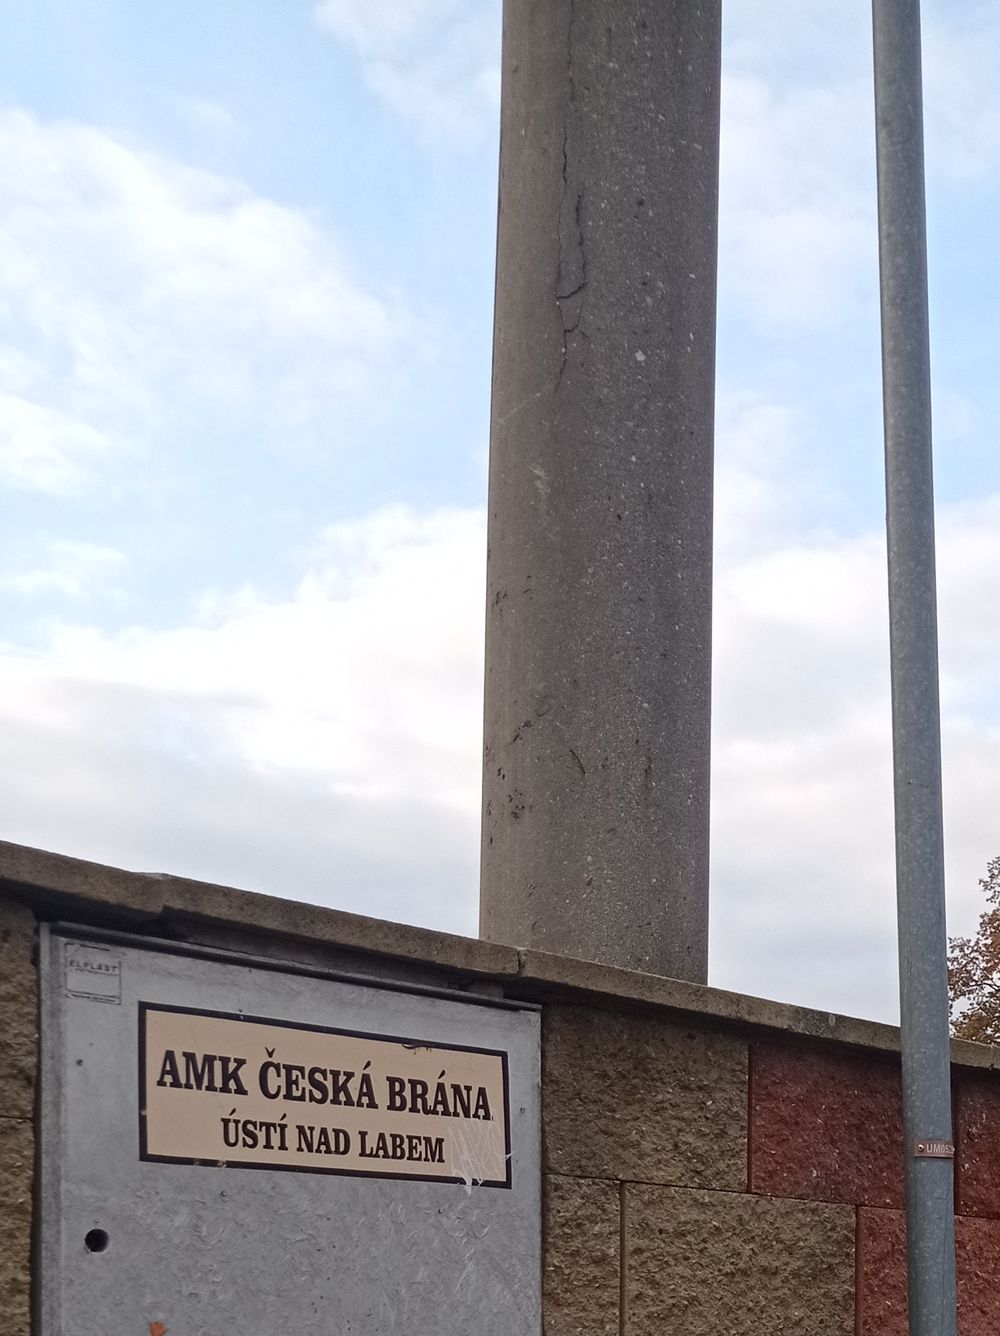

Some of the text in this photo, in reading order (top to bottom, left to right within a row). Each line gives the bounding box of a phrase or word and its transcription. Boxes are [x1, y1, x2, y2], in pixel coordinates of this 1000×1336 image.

[156, 1046, 492, 1121] AMK ČESKÁ BRÁNA
[220, 1107, 446, 1165] ÚSTÍ NAD LABEM
